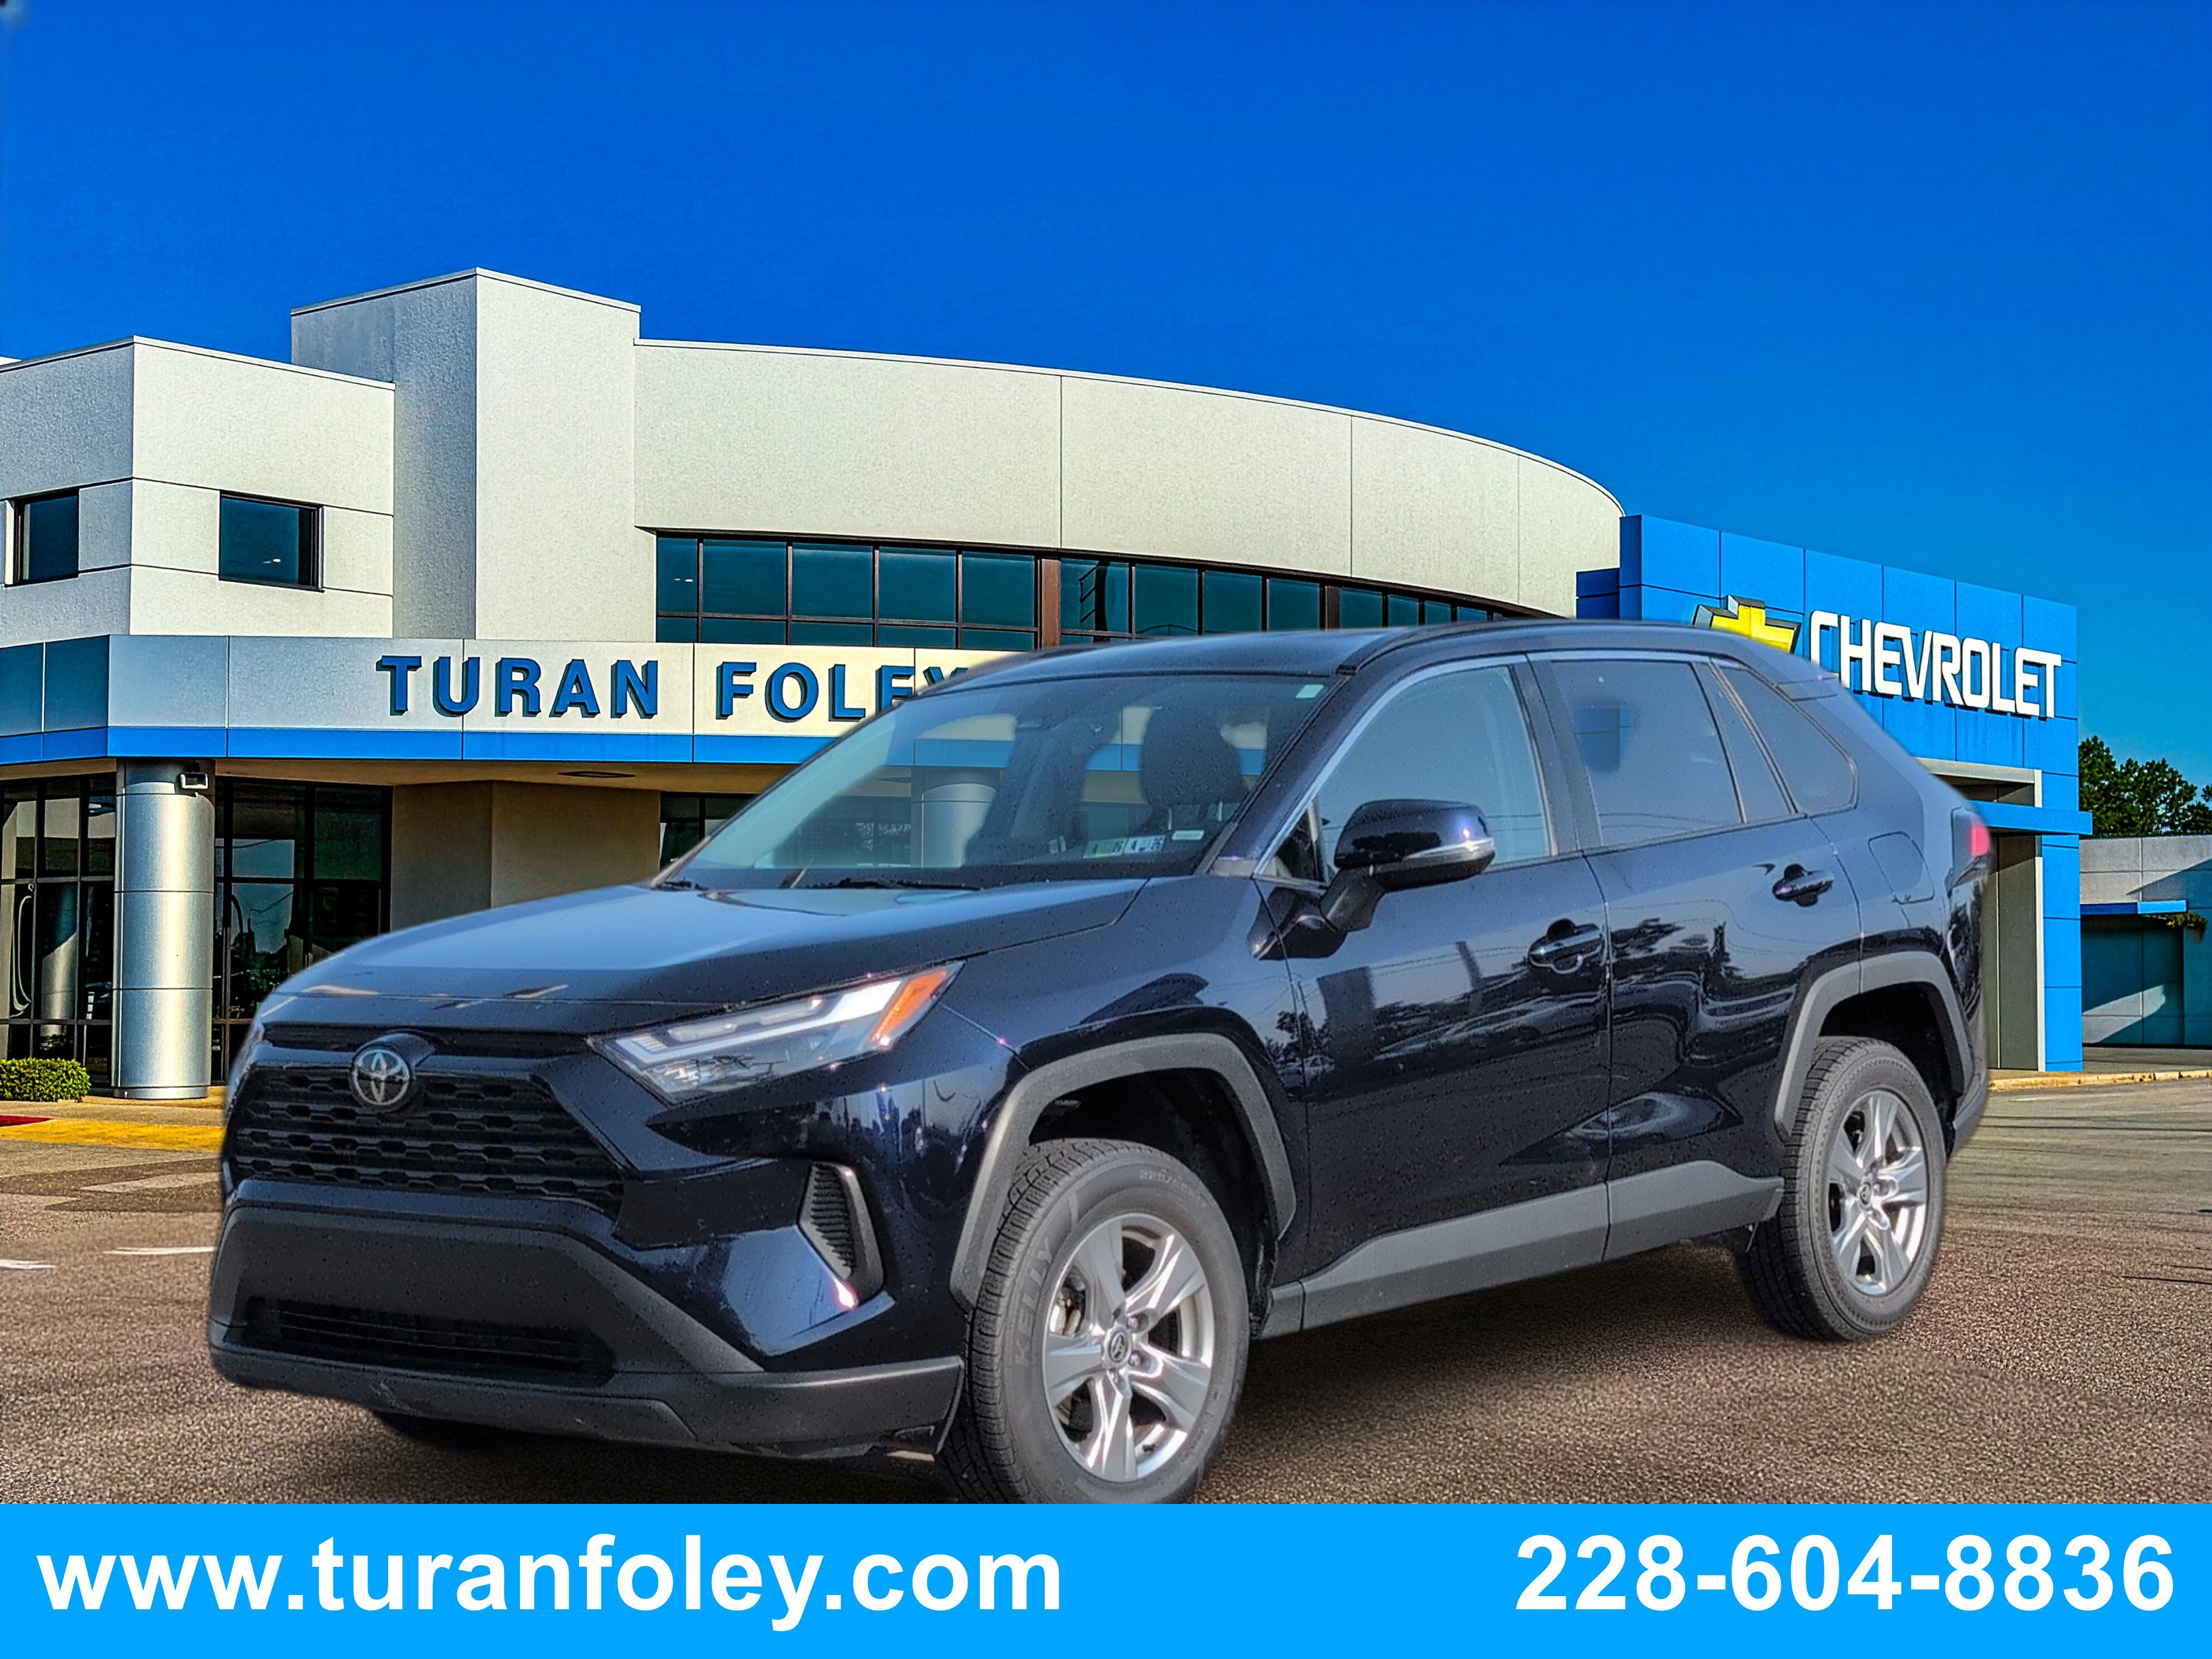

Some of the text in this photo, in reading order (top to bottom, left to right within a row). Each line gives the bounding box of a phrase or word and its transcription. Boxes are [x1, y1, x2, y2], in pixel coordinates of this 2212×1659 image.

[377, 655, 968, 721] TURAN FOLE
[1810, 610, 2062, 721] CHEVROLET
[1015, 1236, 1053, 1368] KELLY
